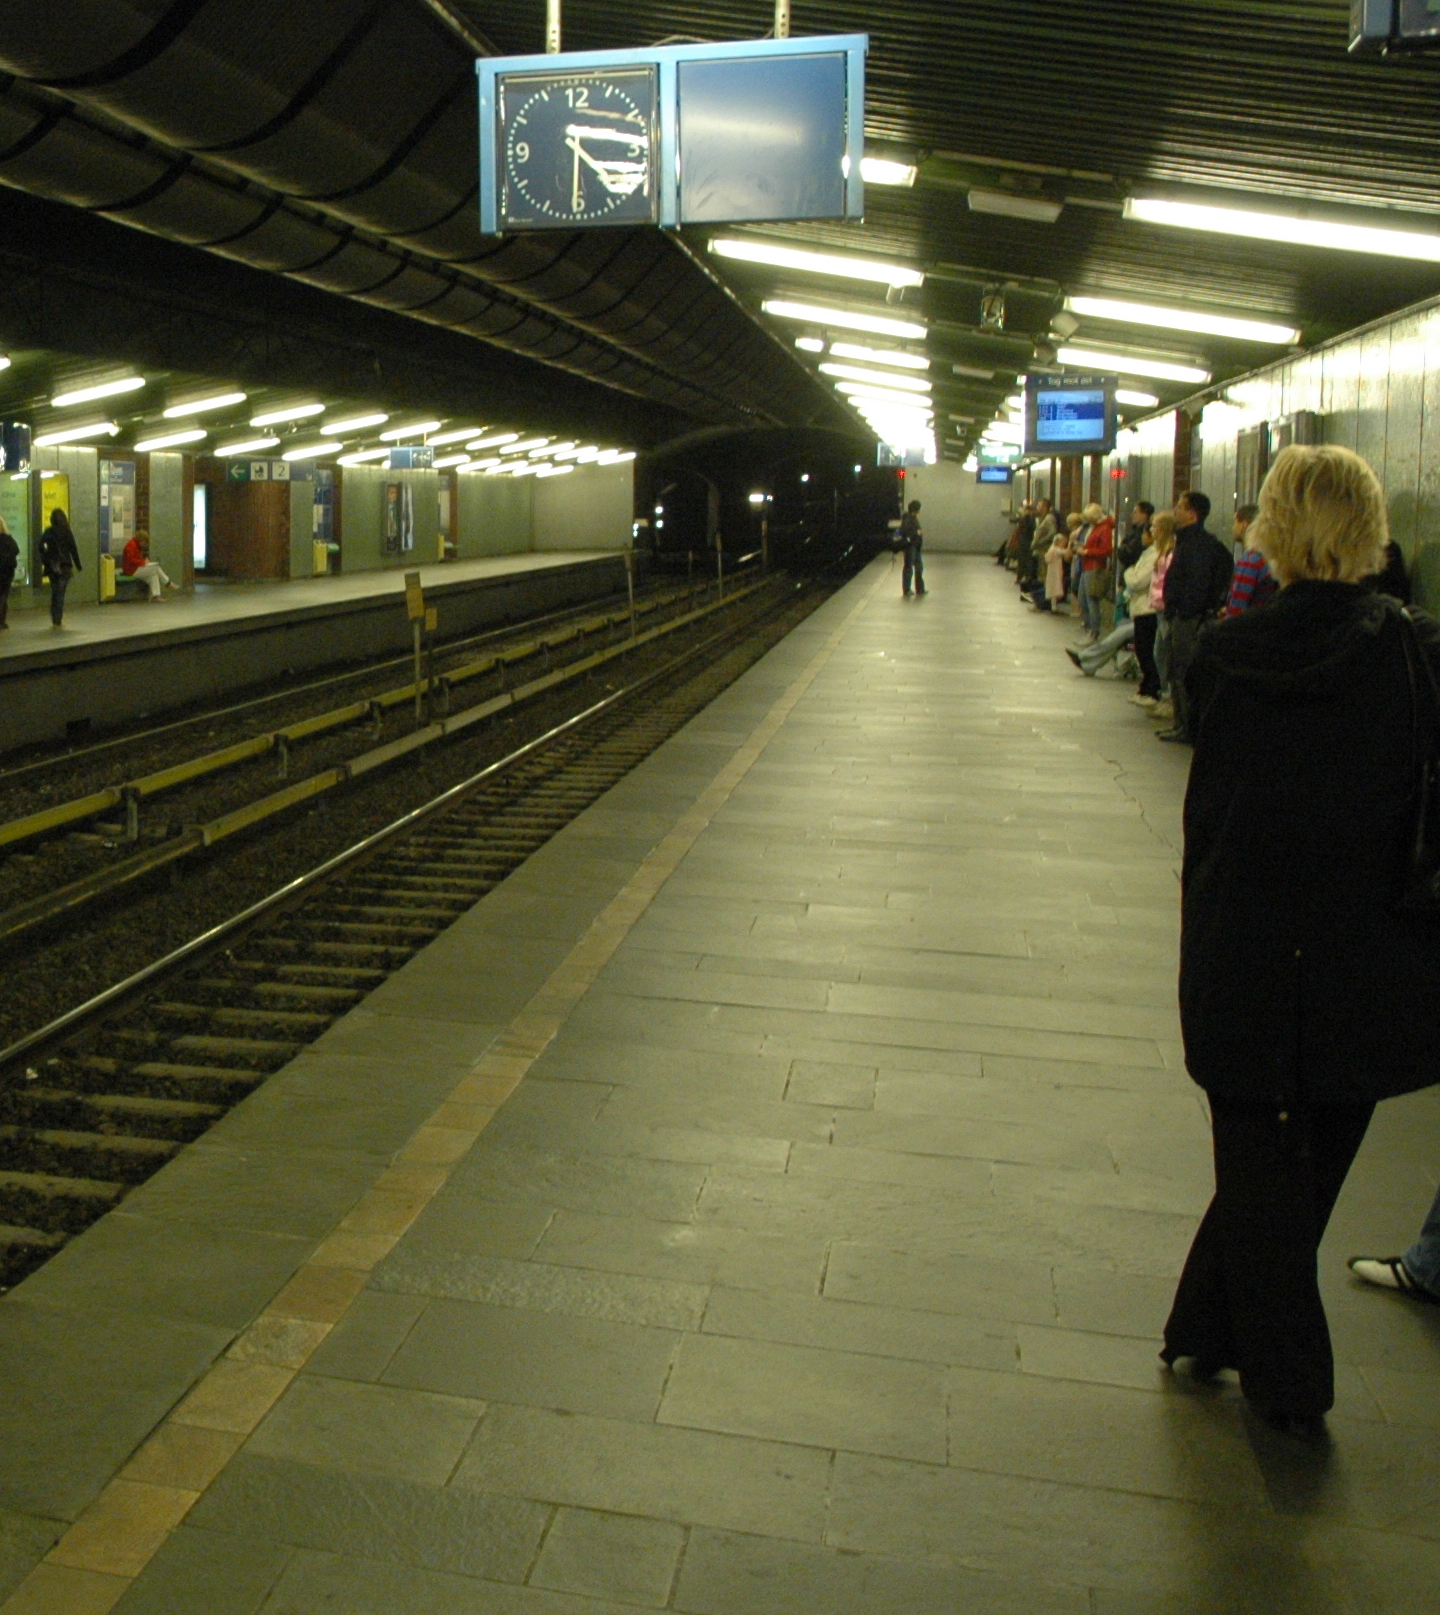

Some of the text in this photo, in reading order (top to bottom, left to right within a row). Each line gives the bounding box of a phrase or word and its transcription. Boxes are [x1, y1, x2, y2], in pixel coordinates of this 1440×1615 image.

[565, 87, 589, 108] 12
[515, 142, 530, 164] 9
[626, 141, 640, 158] 3
[278, 464, 286, 478] 2
